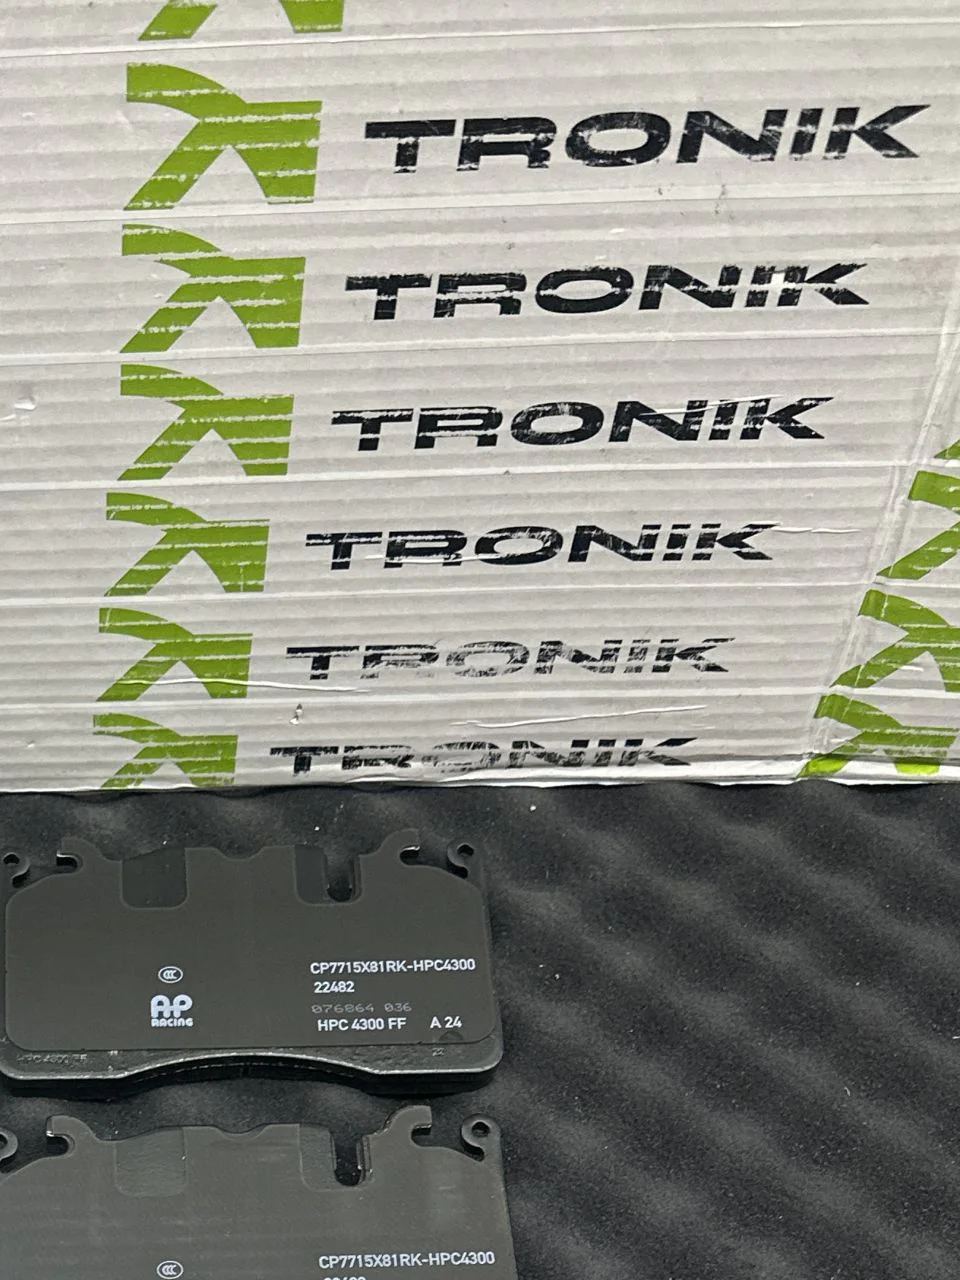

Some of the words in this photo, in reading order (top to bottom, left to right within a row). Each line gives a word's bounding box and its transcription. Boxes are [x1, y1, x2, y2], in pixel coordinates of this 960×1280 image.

[365, 105, 929, 173] TRONIK
[346, 264, 868, 320] TRONIK
[331, 397, 834, 451] TRONIK
[305, 523, 779, 571] TRONIK
[287, 638, 733, 680] TRONIK
[270, 738, 696, 774] TRONIK
[309, 958, 476, 975] CP7715X81RK-HPC4300
[313, 980, 355, 994] 22482
[151, 994, 192, 1018] AP
[311, 1003, 375, 1014] 076864
[383, 1002, 413, 1013] 036
[151, 1018, 193, 1027] RACING
[317, 1018, 349, 1032] HPC
[350, 1017, 385, 1031] 4300
[387, 1017, 407, 1030] FF
[429, 1016, 442, 1029] A
[443, 1015, 463, 1029] 24
[318, 1250, 496, 1269] CP7715X81RK-HPC4300
